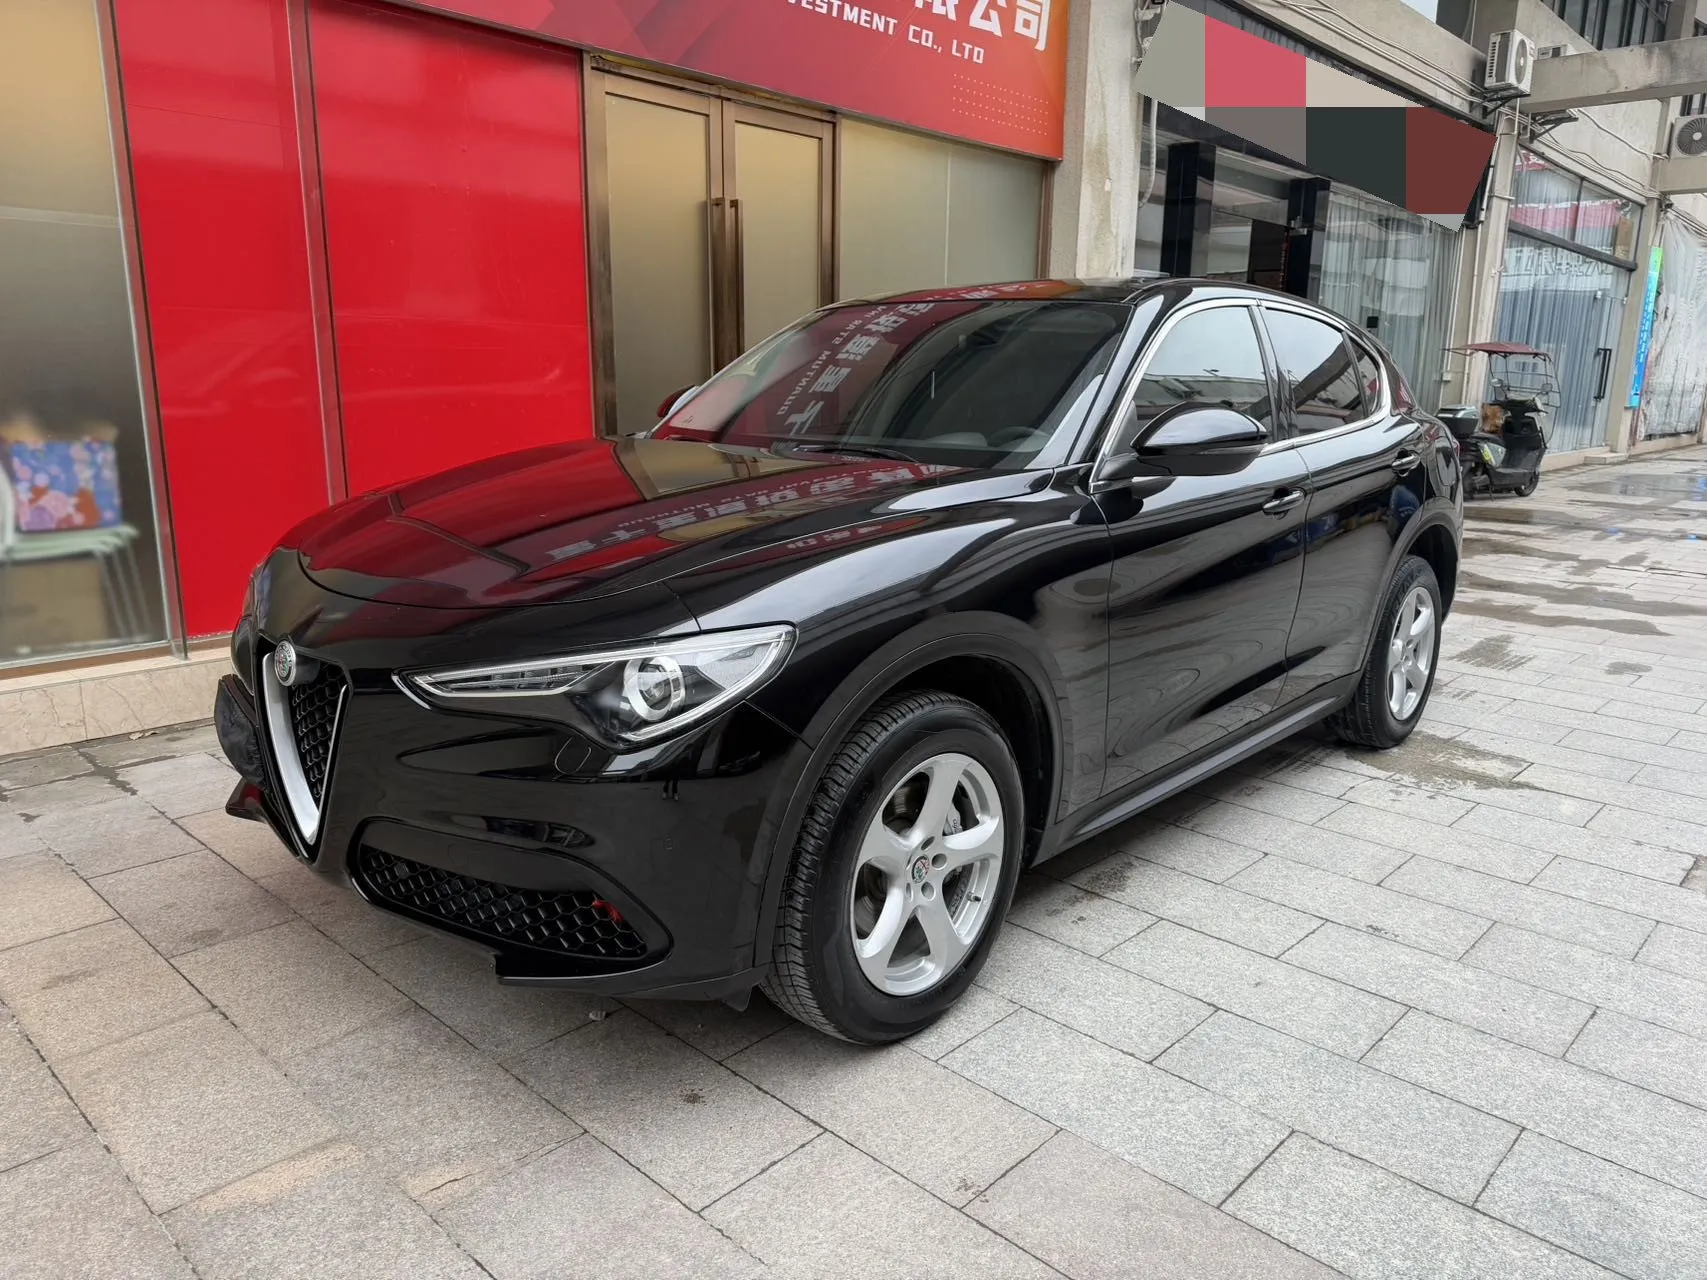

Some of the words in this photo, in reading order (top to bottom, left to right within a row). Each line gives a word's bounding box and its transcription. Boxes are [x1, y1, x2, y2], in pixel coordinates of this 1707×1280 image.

[787, 0, 898, 36] ESTMENT
[907, 24, 942, 53] CO.,
[951, 39, 985, 64] LTD
